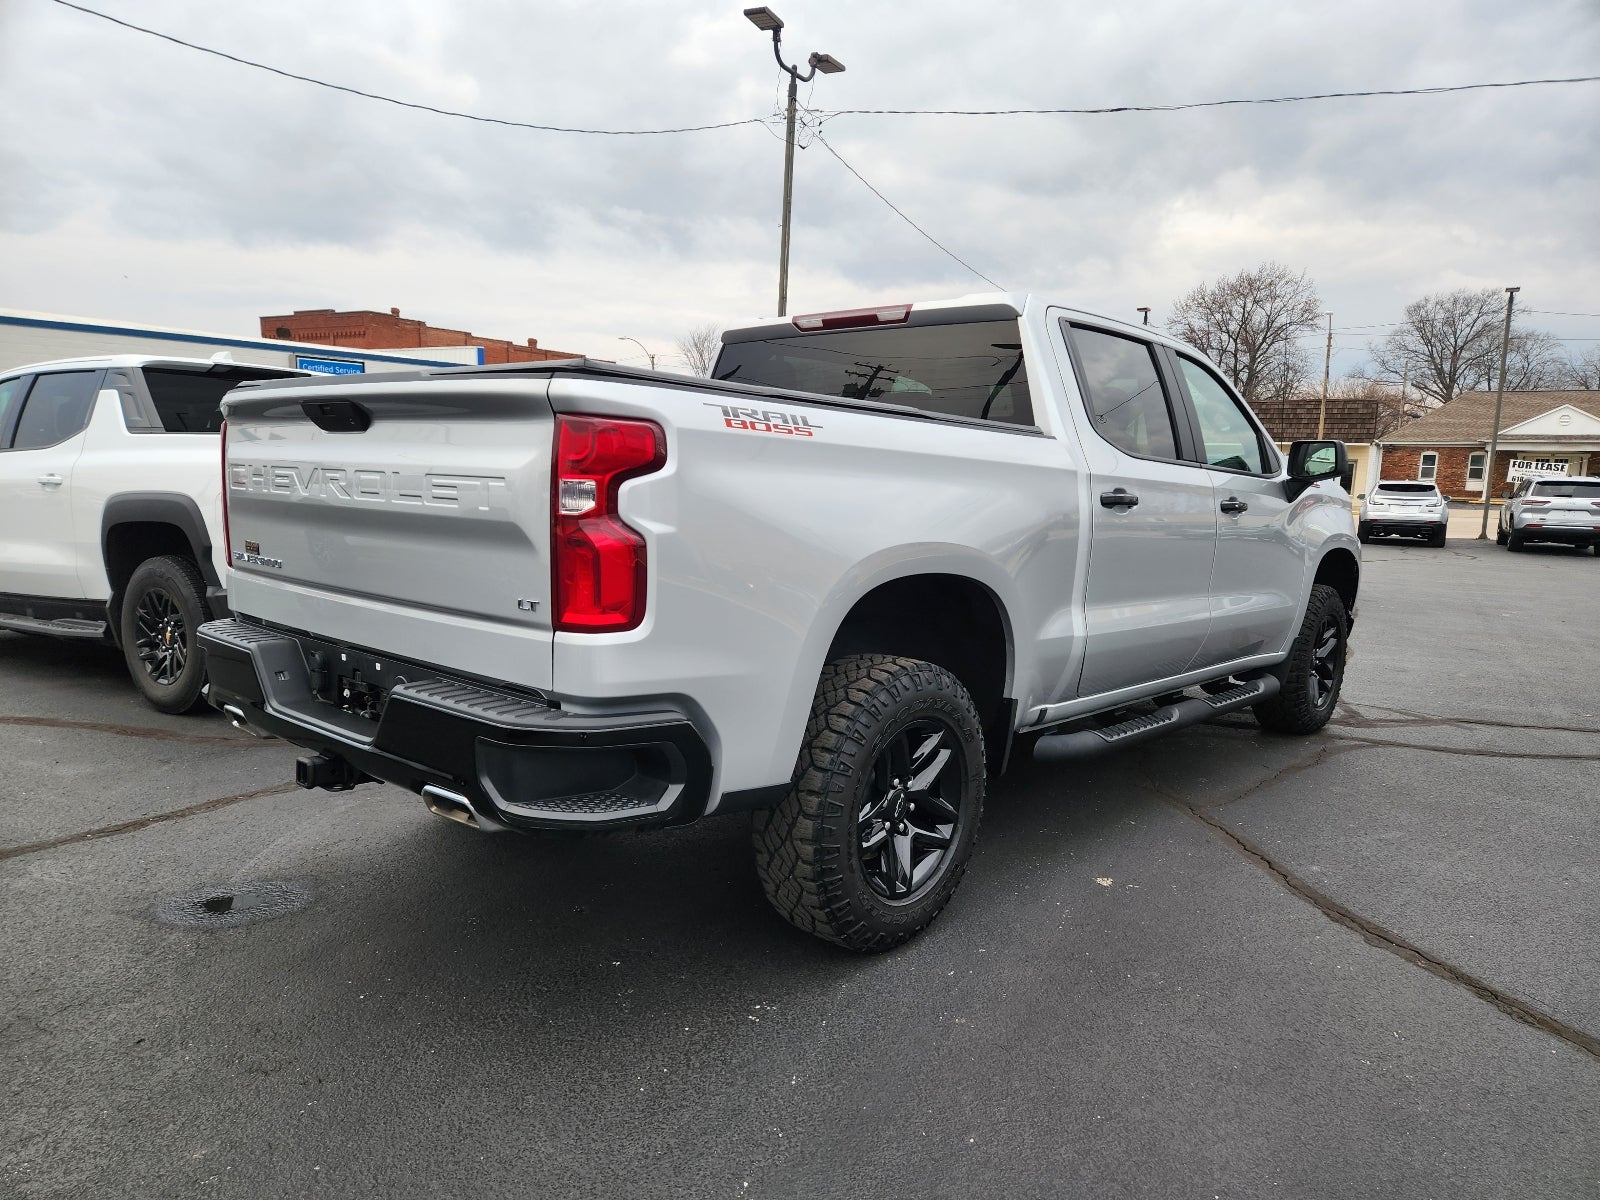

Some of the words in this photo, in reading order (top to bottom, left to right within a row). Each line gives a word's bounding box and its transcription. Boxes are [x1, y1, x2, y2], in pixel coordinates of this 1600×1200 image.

[302, 363, 334, 373] Certified
[335, 366, 361, 375] Service
[703, 402, 823, 428] TRAIL
[724, 417, 813, 437] BOSS
[1512, 461, 1533, 469] FOR
[1535, 463, 1567, 472] LEASE
[229, 463, 506, 511] CHEVROLET
[517, 598, 541, 613] LT
